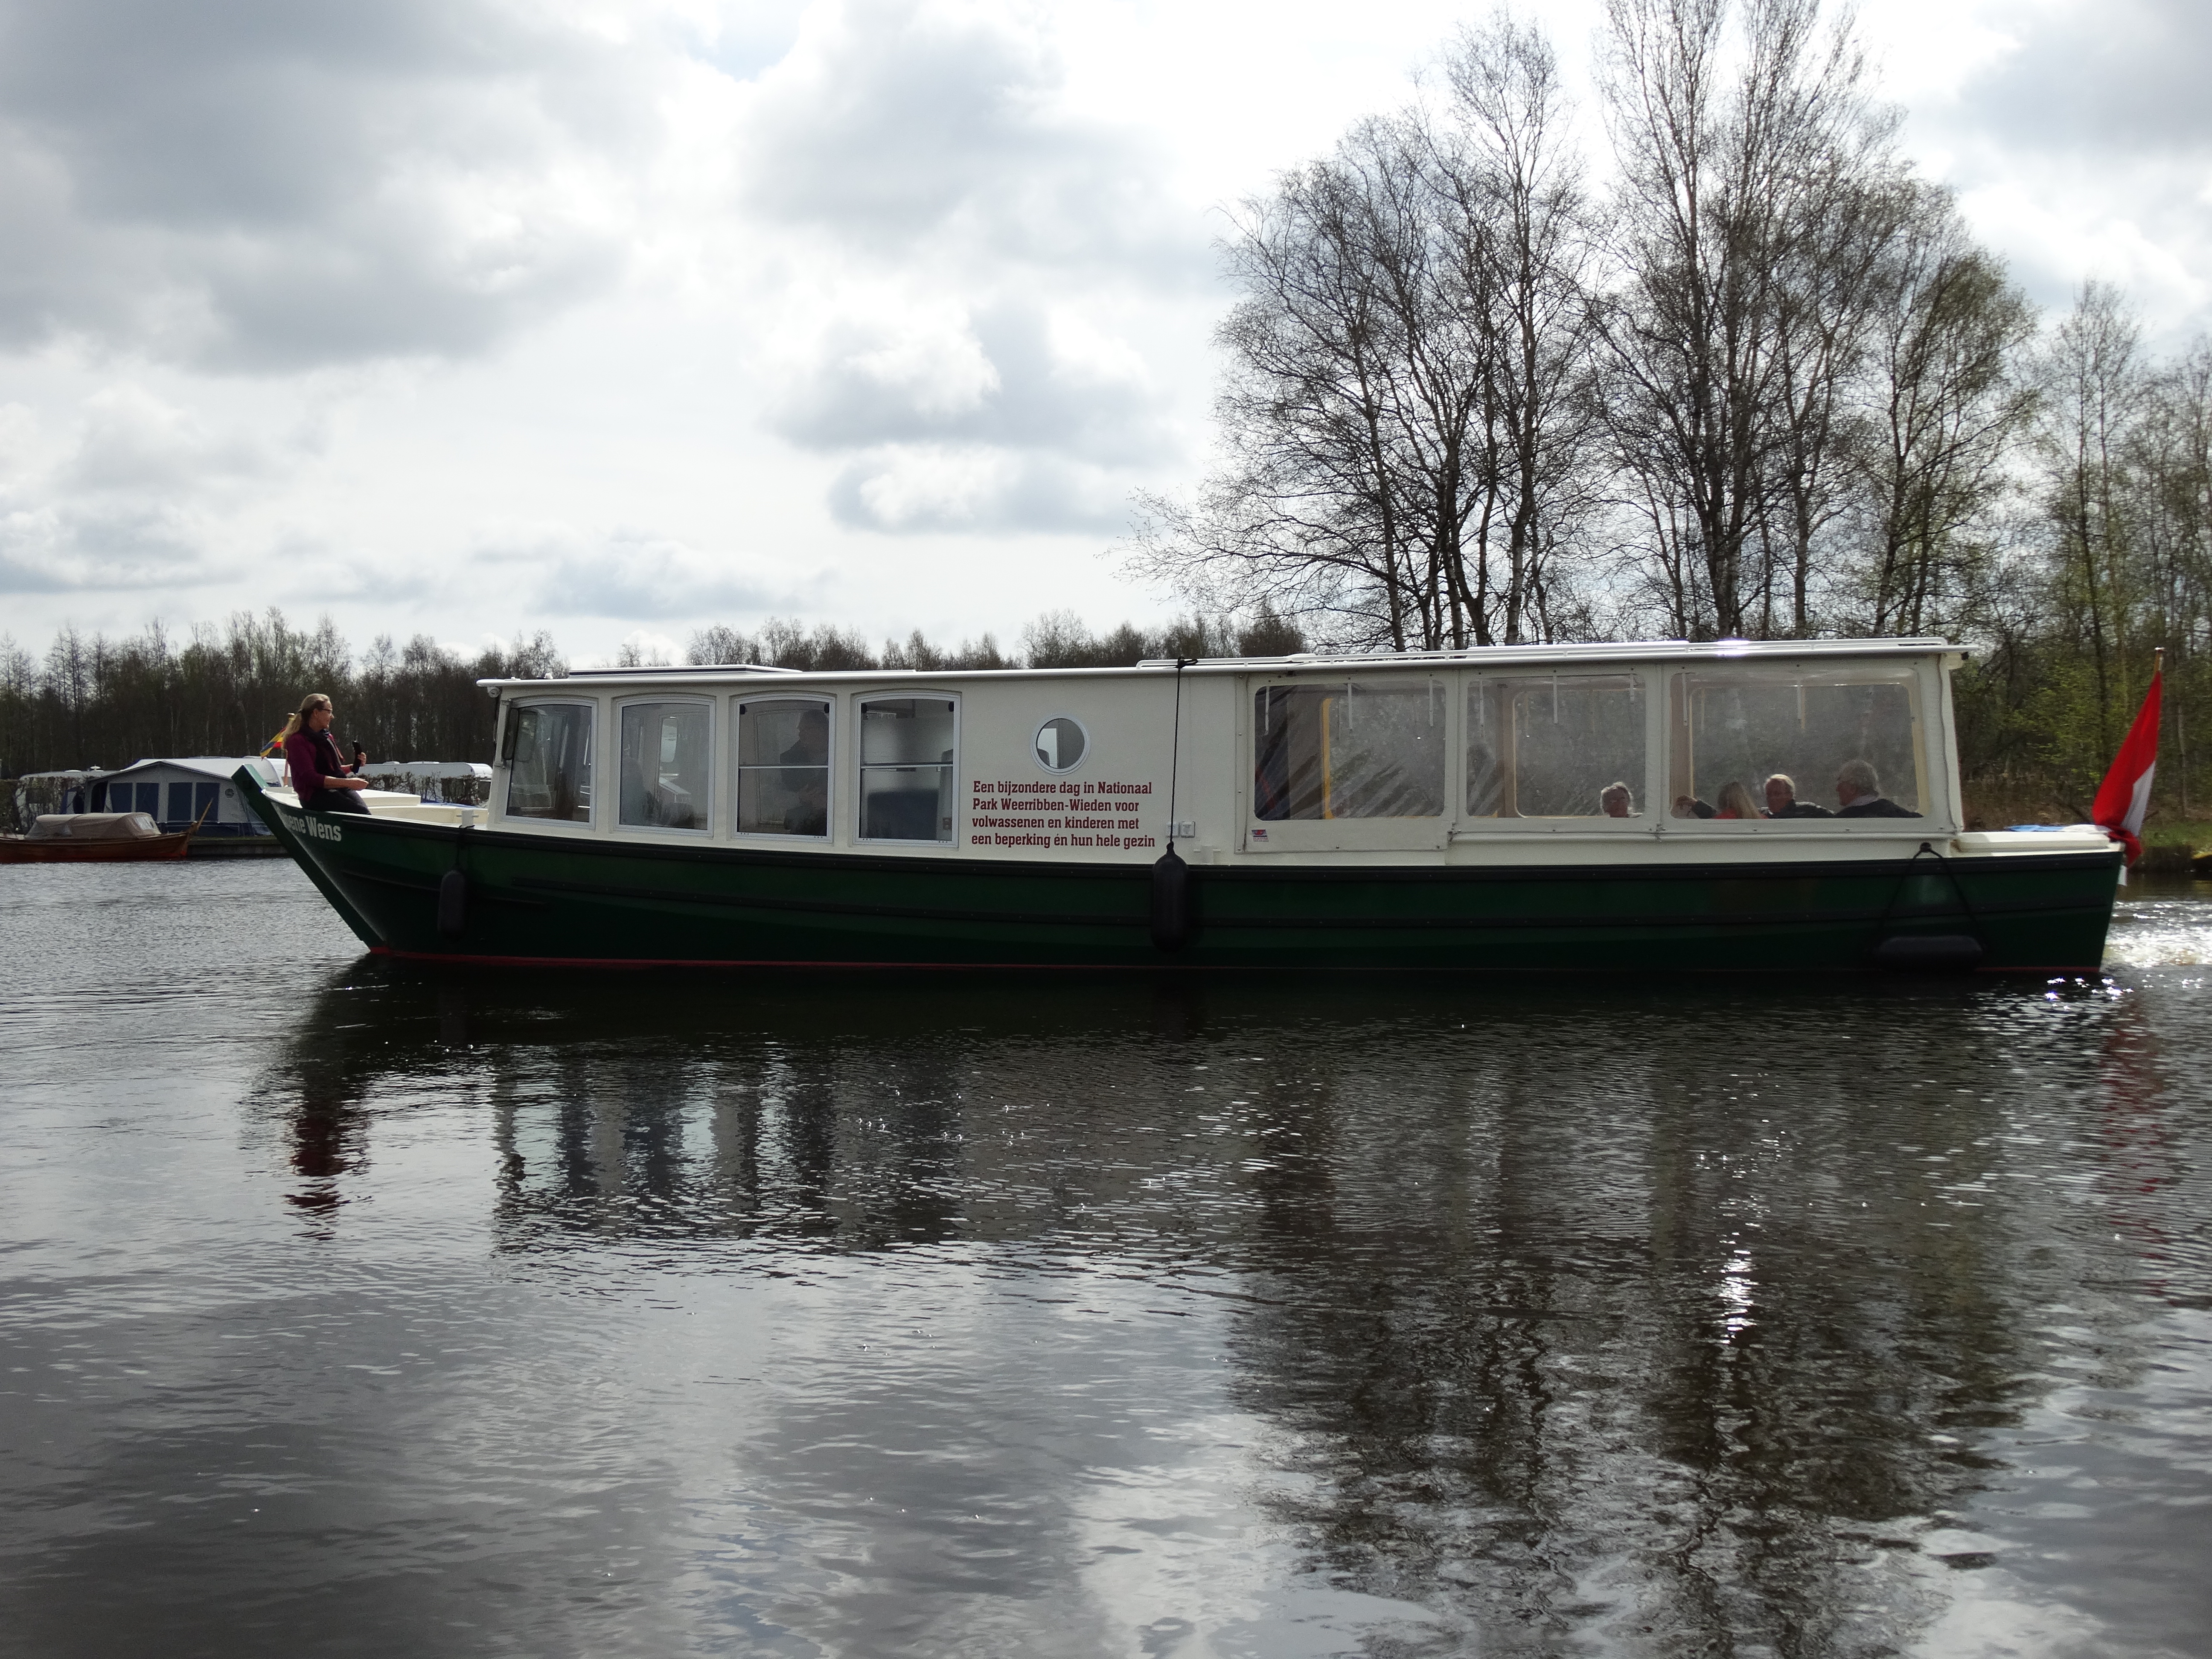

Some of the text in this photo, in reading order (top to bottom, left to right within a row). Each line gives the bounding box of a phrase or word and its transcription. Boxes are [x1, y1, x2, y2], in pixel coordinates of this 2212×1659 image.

[973, 780, 1152, 797] Een bijzondere dag in Nationaal
[972, 797, 1139, 812] Park Weerribben-Wieden voor
[305, 815, 341, 841] Wens
[972, 815, 1139, 830] volwassenen en kinderen met
[972, 832, 1155, 850] een beperking én hun hele gezin
